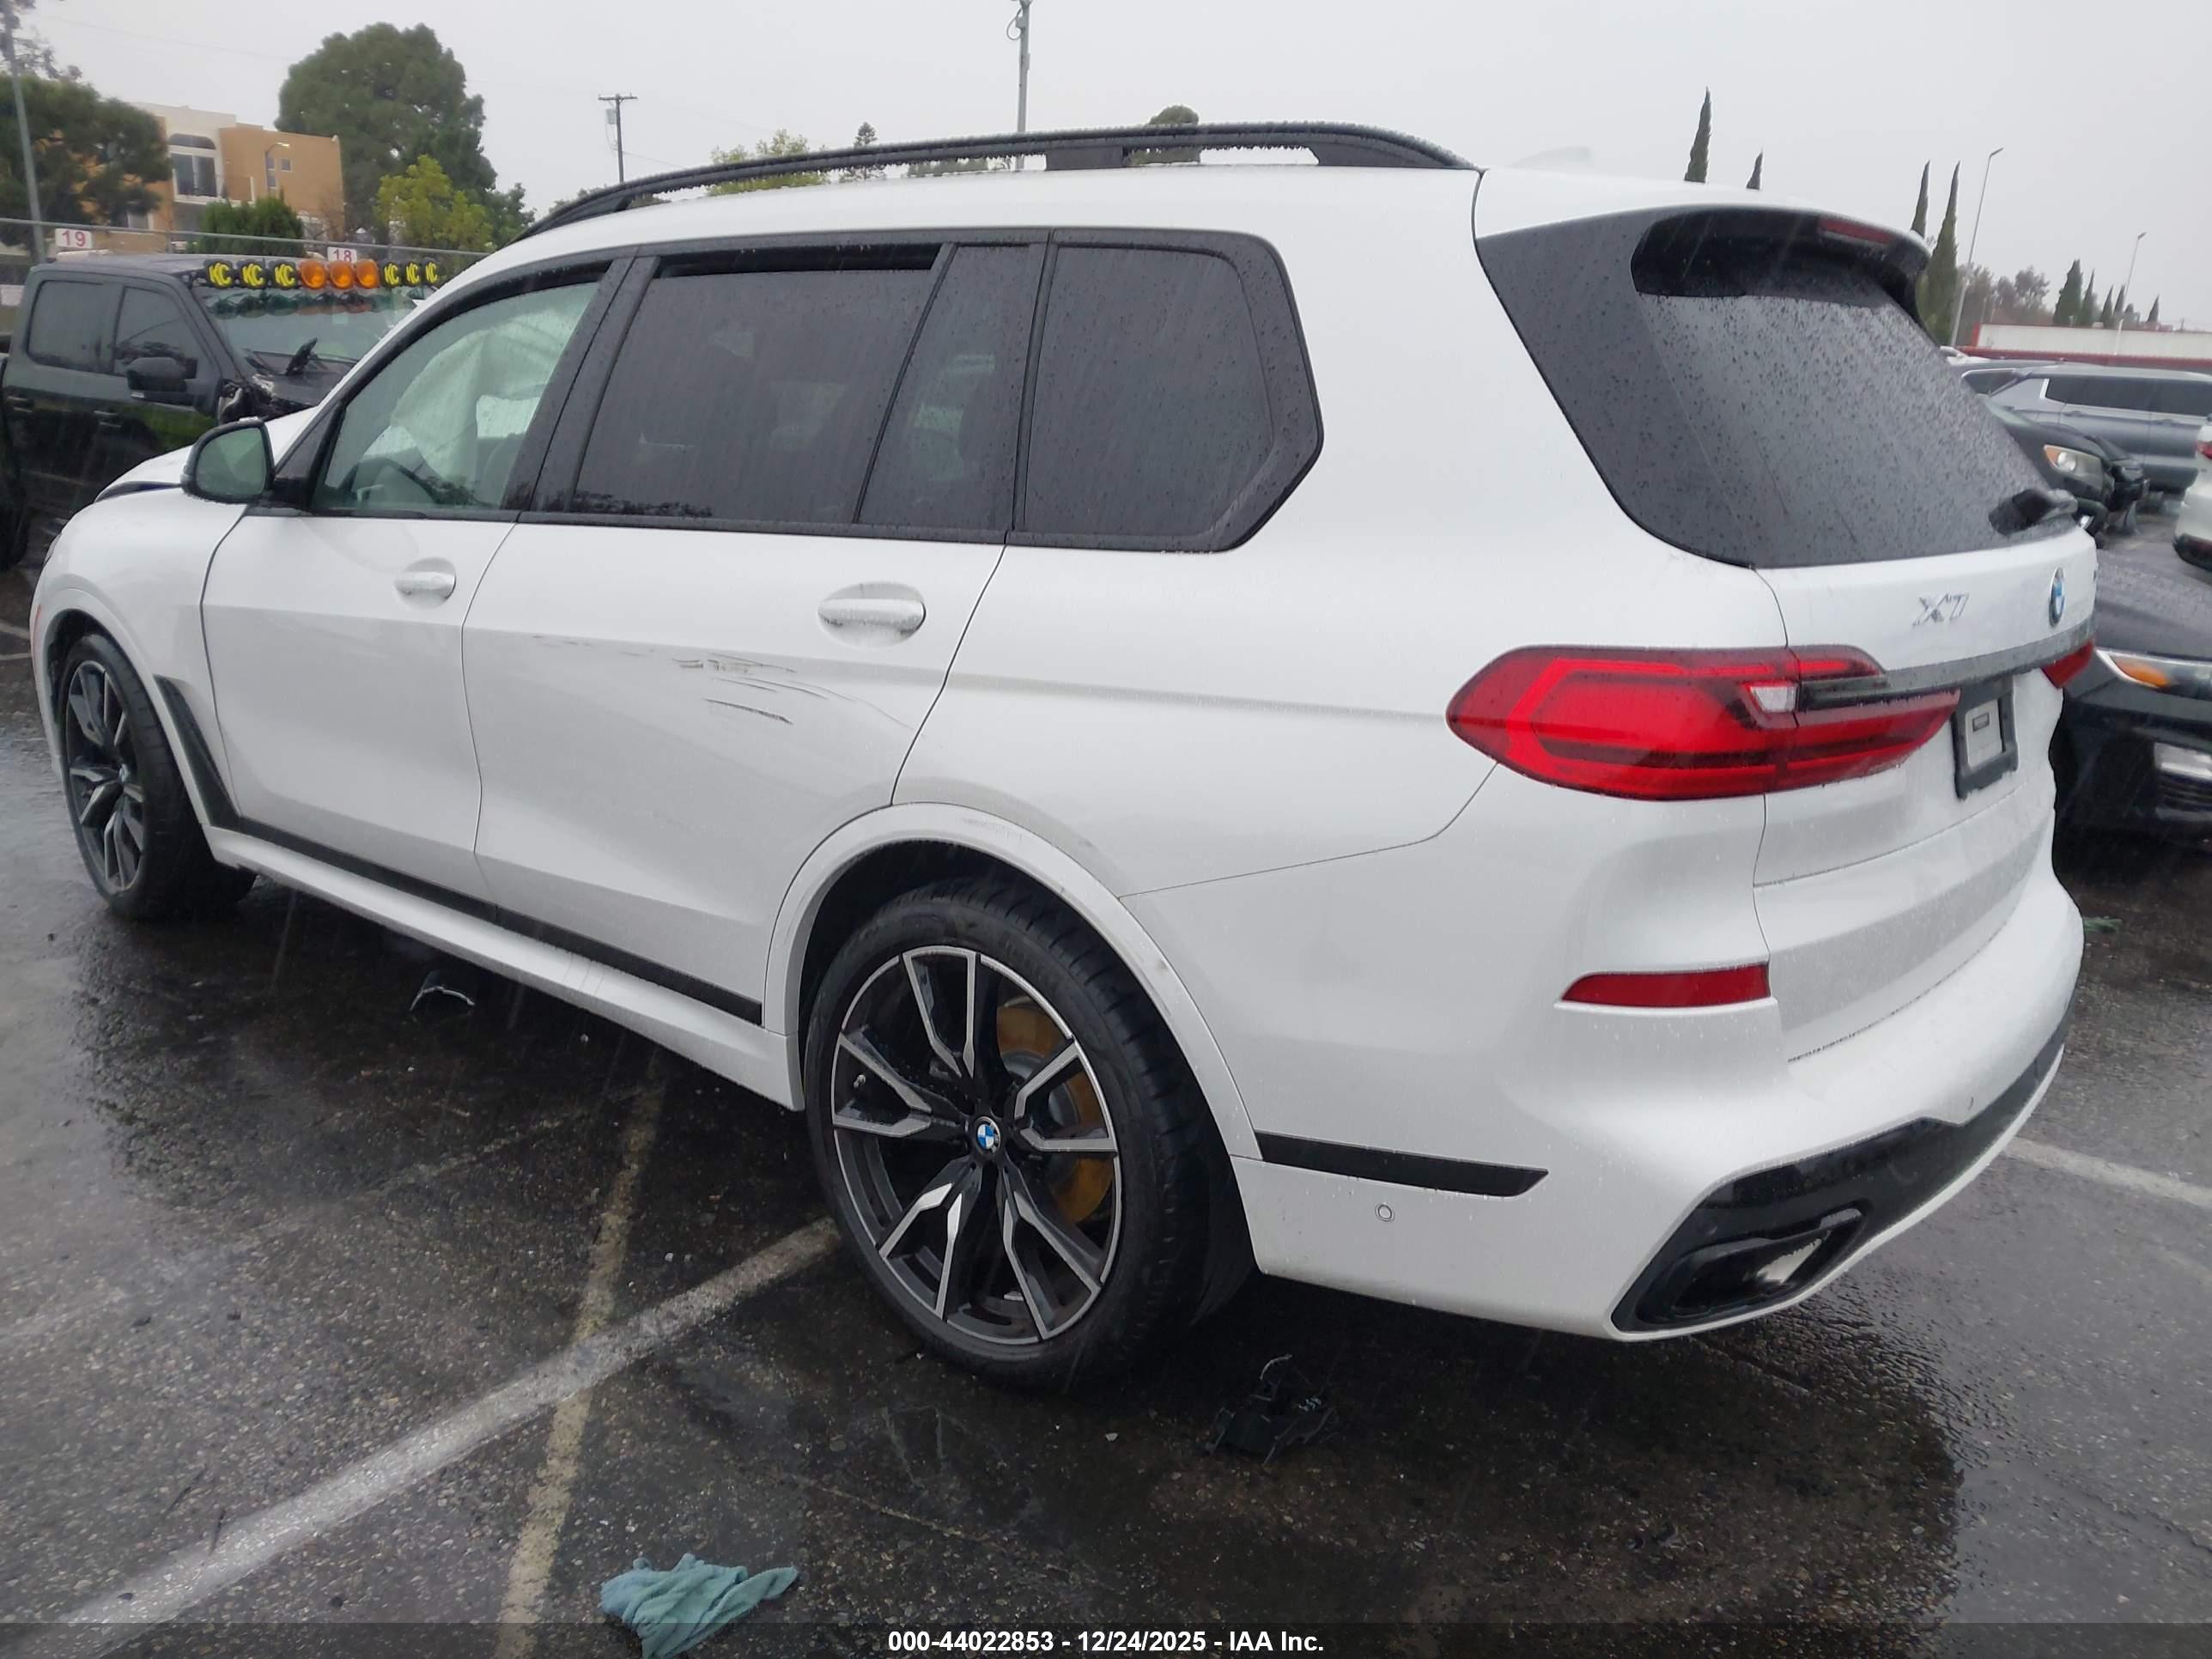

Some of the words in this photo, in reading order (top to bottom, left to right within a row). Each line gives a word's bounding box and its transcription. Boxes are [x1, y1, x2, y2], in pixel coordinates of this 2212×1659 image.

[61, 230, 86, 247] 19
[333, 248, 352, 261] 18
[209, 263, 232, 286] KC
[241, 264, 264, 287] KC
[274, 264, 295, 287] KC
[384, 263, 399, 285] KC
[405, 263, 420, 284] KC
[425, 262, 438, 283] KC
[1911, 592, 1971, 626] X7
